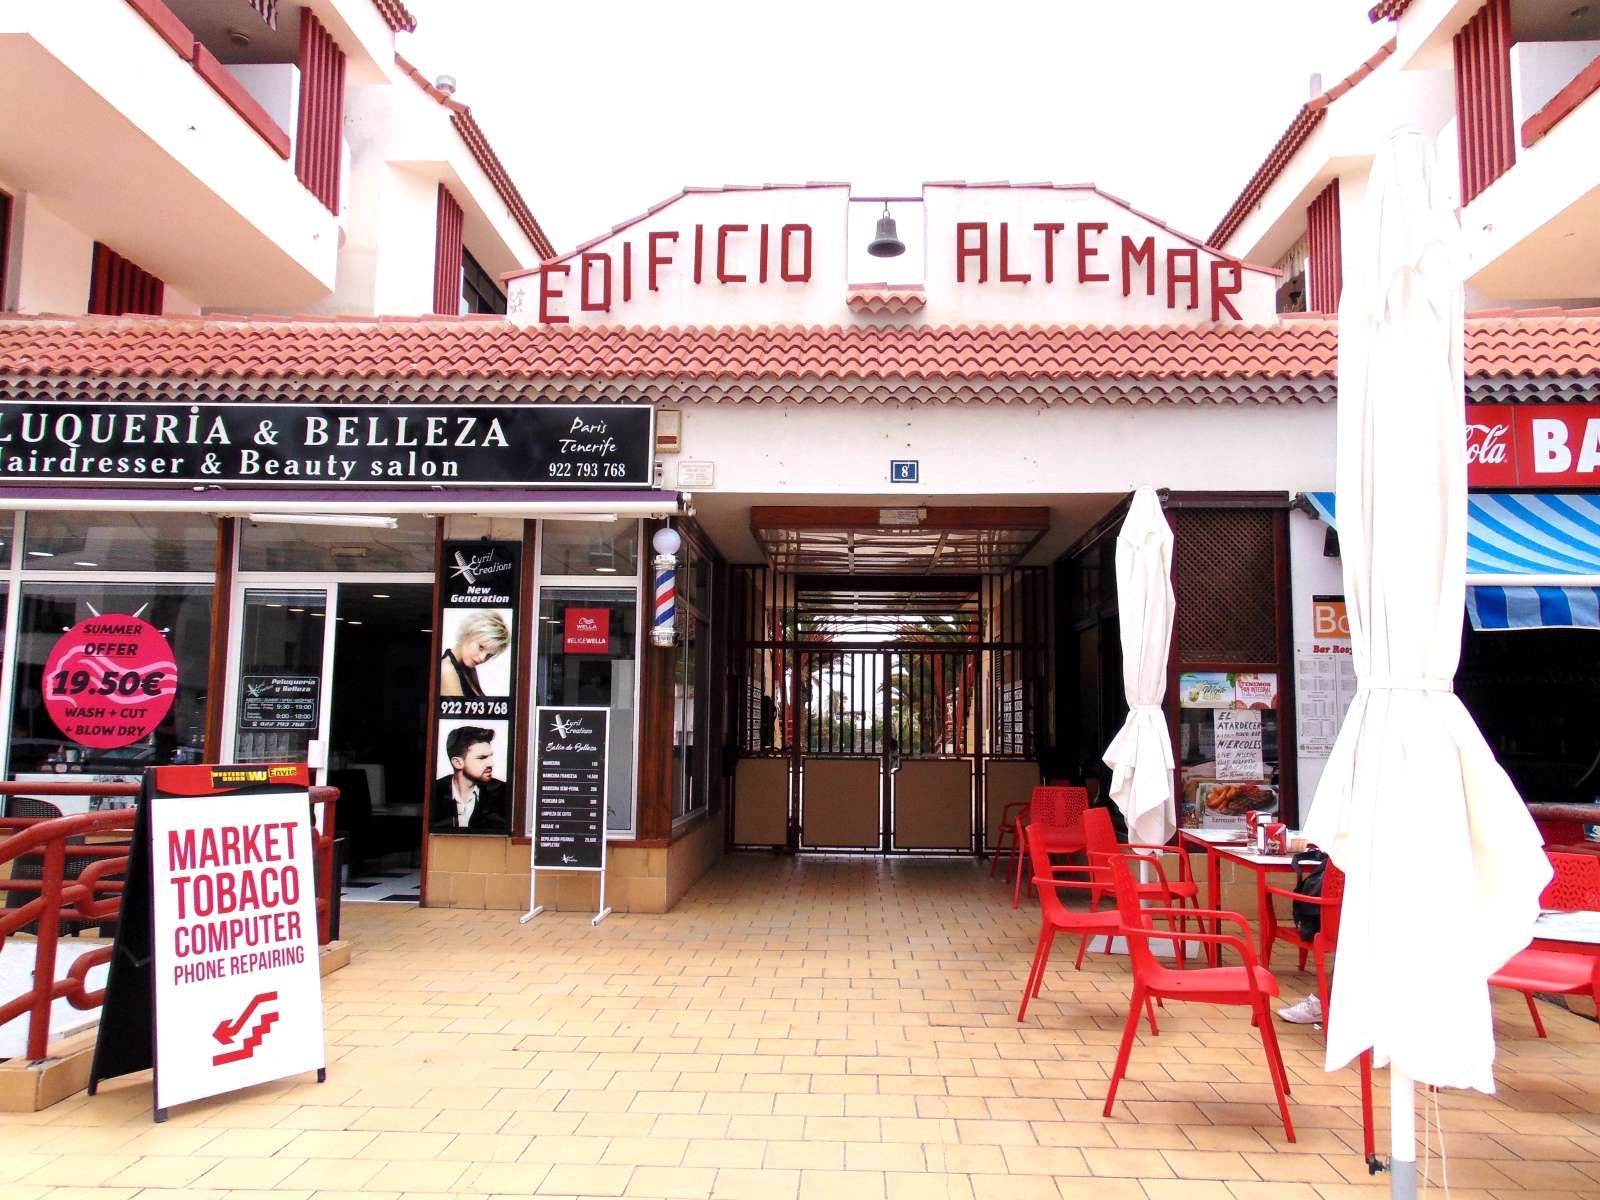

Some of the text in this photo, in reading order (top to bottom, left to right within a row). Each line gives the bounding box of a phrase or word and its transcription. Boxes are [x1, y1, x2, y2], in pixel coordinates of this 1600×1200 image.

[539, 222, 1243, 323] EDIFICIO ALTEMAR
[253, 419, 279, 445] &
[304, 416, 509, 447] BELLEZA
[570, 416, 607, 434] Paris
[559, 438, 616, 457] Tenerife
[1466, 424, 1509, 464] ola
[0, 448, 459, 481] airdresser & Beauty salon
[549, 463, 625, 477] 922 793 768
[901, 465, 909, 478] 8
[471, 549, 495, 566] Cyril
[472, 562, 512, 576] Creations
[467, 585, 491, 594] New
[451, 594, 509, 603] Generation
[83, 624, 142, 634] SUMMER
[85, 643, 138, 656] OFFER
[1313, 645, 1330, 653] Bar
[53, 671, 166, 696] 19.50€
[65, 707, 104, 718] WASH
[120, 708, 147, 718] CUT
[441, 701, 508, 715] 922 793 768
[1218, 712, 1231, 720] EL
[76, 725, 114, 736] BLOW
[117, 726, 145, 737] DRY
[1217, 721, 1262, 730] ATARDECER
[1217, 740, 1262, 749] MIERCOLES
[168, 822, 298, 871] MARKET
[170, 865, 300, 920] TOBACO
[175, 911, 301, 958] COMPUTER
[174, 945, 305, 986] PHONE REPAIRING
